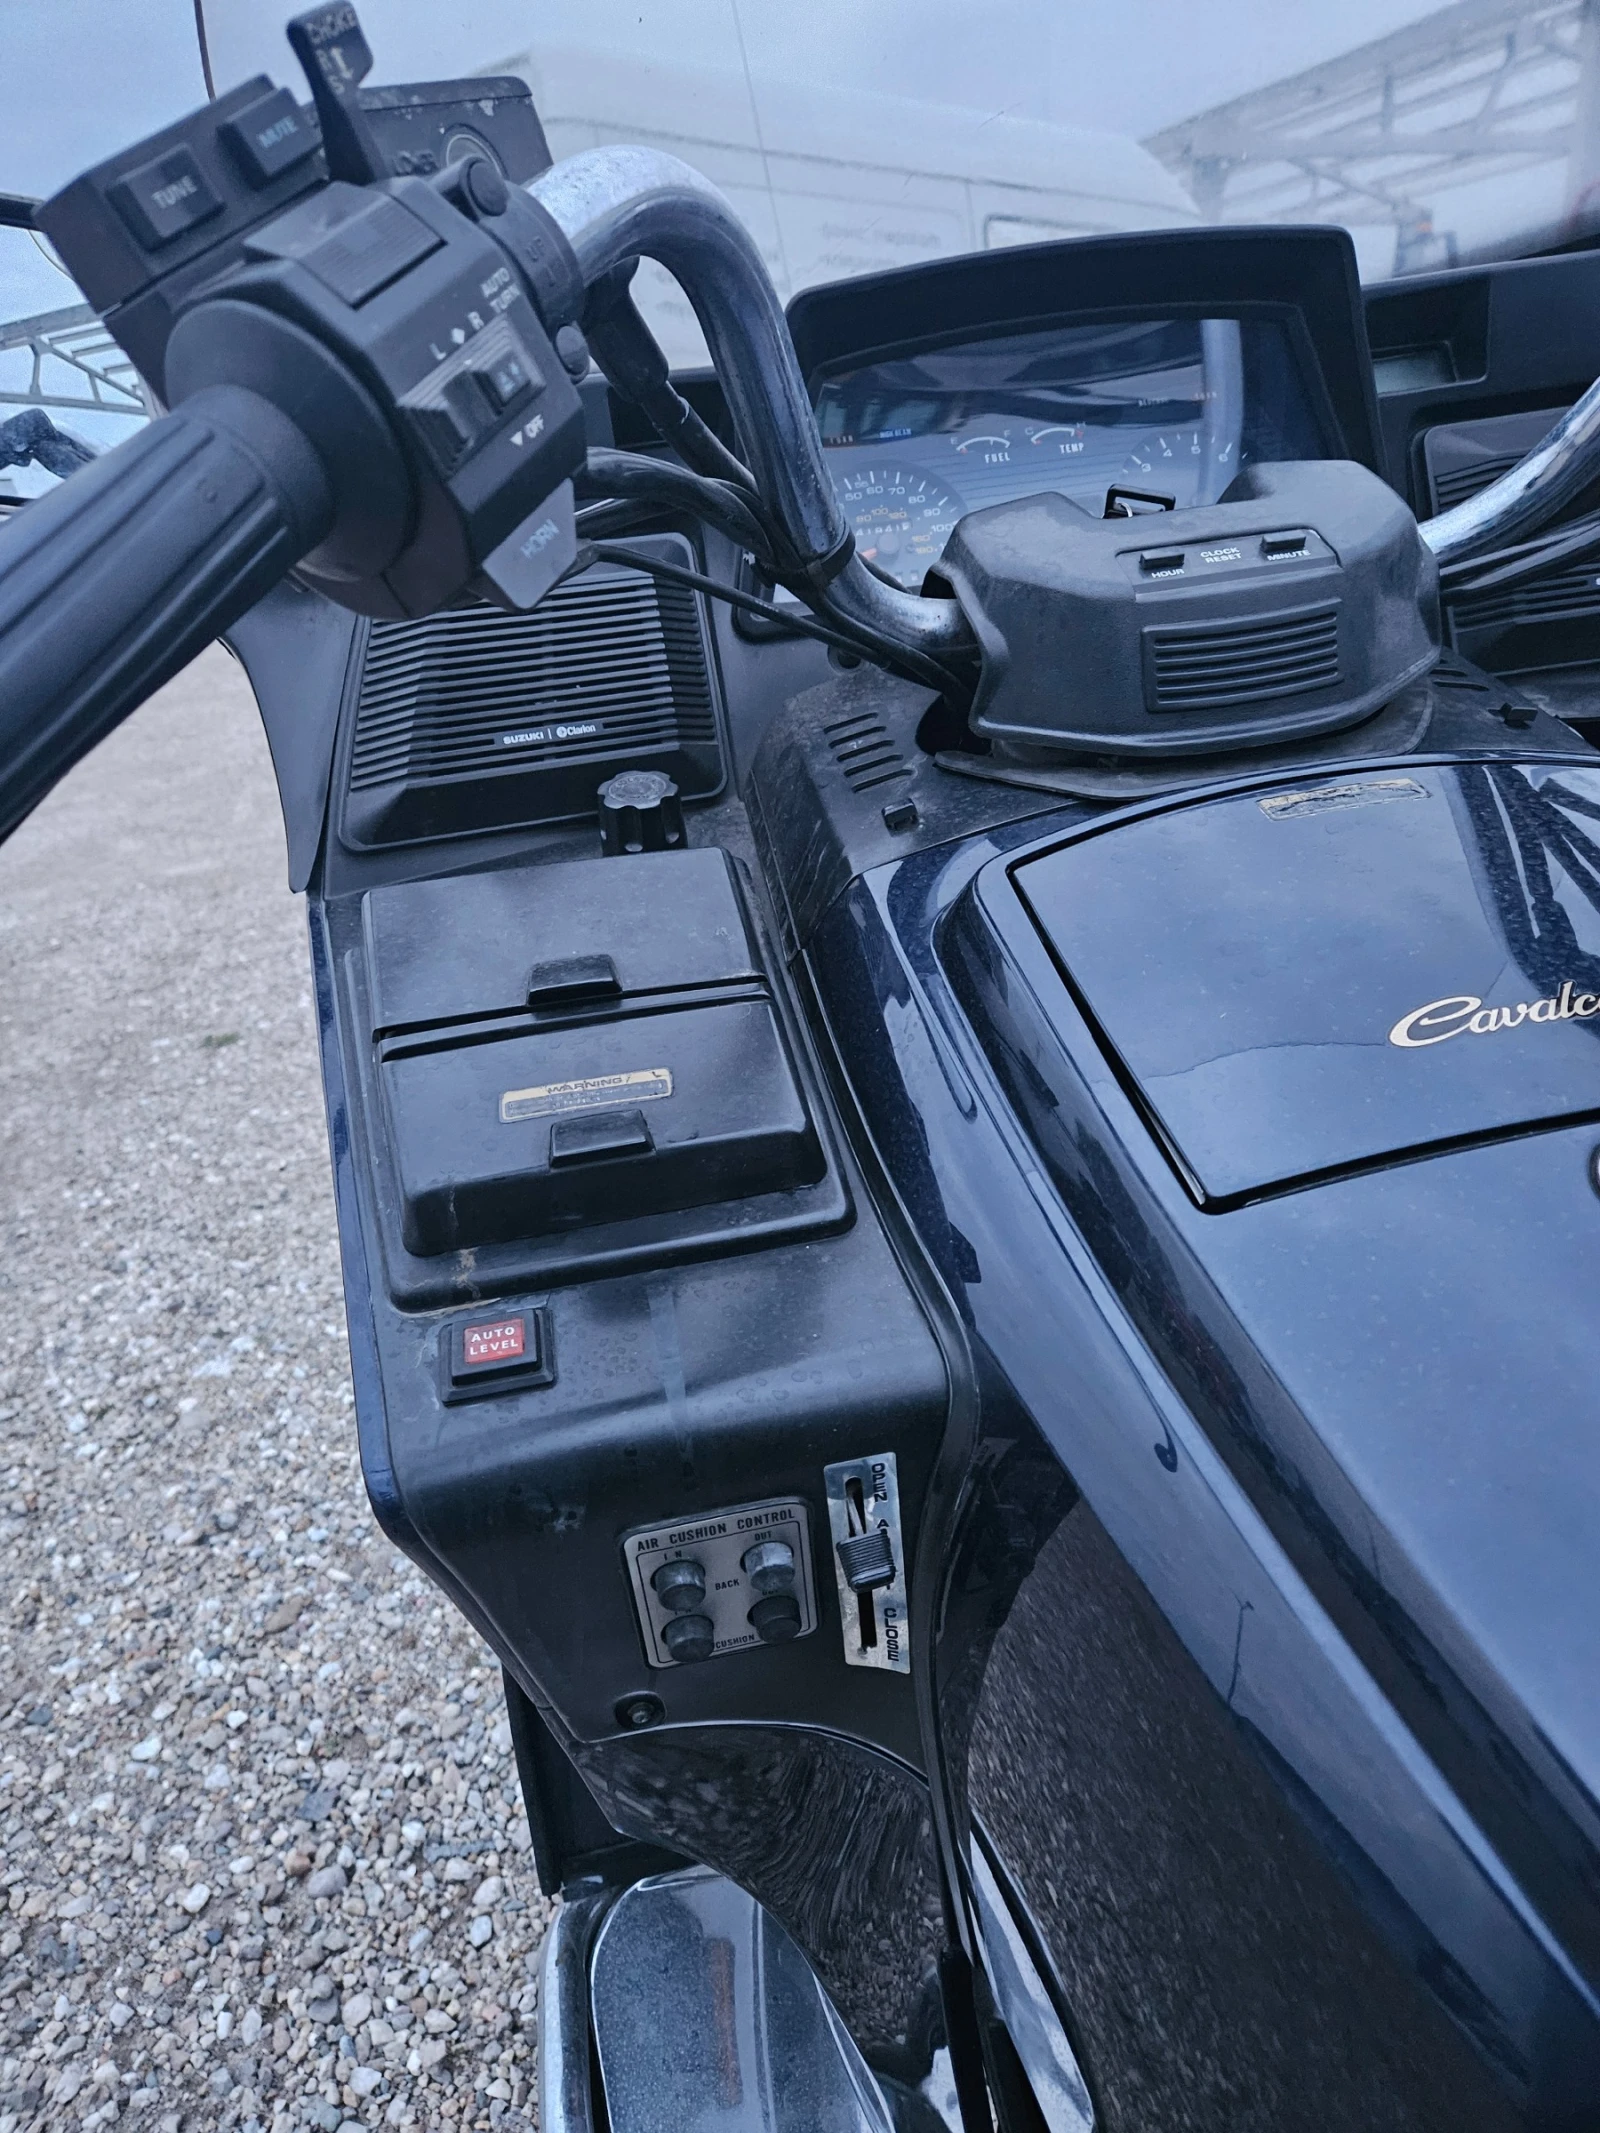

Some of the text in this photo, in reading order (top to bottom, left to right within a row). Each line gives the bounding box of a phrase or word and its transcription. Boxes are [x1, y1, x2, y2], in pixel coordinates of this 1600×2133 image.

[257, 115, 299, 148] MUTE
[151, 175, 197, 209] TUNE
[480, 267, 510, 298] AUTO
[467, 311, 484, 330] R
[429, 343, 446, 360] L
[1059, 442, 1084, 454] TEMP
[984, 452, 1010, 463] FUEL
[845, 491, 862, 501] 50
[866, 485, 883, 495] 60
[887, 486, 905, 495] 70
[908, 495, 925, 504] 80
[923, 508, 940, 517] 90
[930, 523, 955, 533] 100
[521, 519, 559, 559] HORN
[1200, 547, 1240, 558] CLOCK
[1205, 553, 1242, 564] RESET
[1267, 550, 1311, 561] MINUTE
[1151, 568, 1185, 579] HOUR
[503, 724, 596, 744] SUZUKI Clarion
[1389, 981, 1600, 1047] Cavalc
[471, 1327, 515, 1343] AUTO
[470, 1339, 518, 1355] LEVEL
[872, 1463, 888, 1503] OPEN
[637, 1509, 795, 1551] AIR CUSHION CONTROL
[754, 1530, 772, 1541] OUT
[715, 1579, 740, 1591] BACK
[884, 1608, 899, 1661] CLOSE
[716, 1634, 755, 1649] CUSHION
